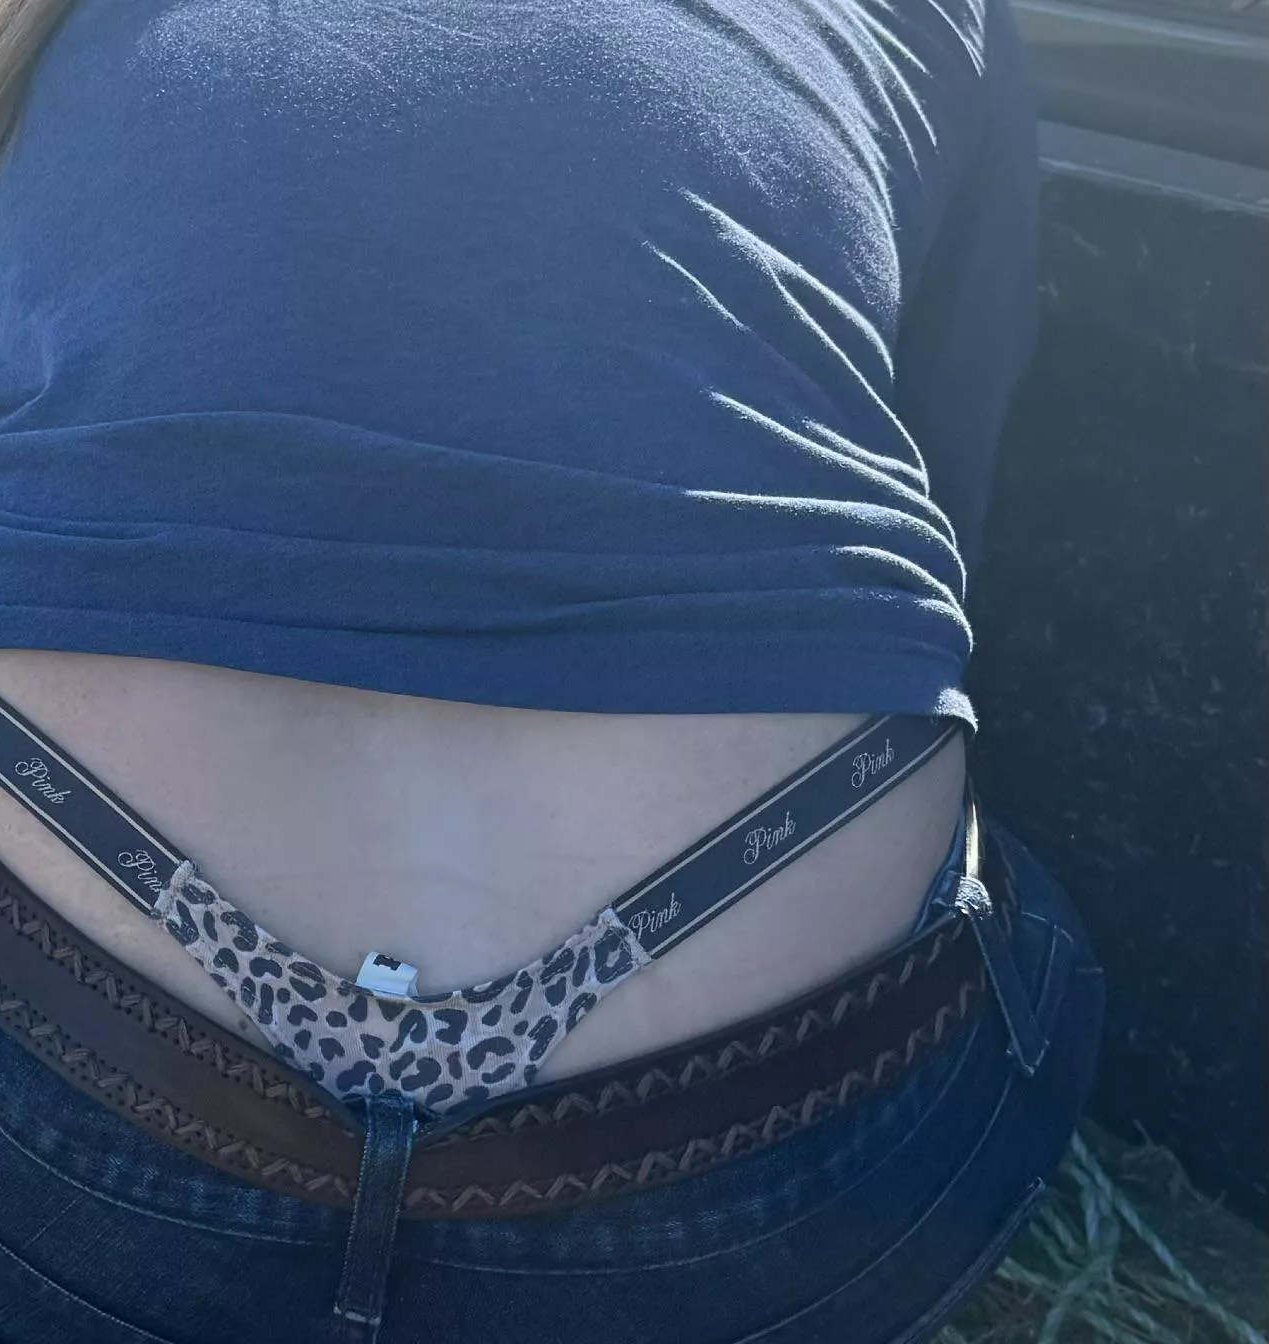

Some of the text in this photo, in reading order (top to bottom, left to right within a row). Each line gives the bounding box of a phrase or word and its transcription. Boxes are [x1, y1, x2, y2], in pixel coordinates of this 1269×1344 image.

[14, 757, 72, 804] Pink
[851, 738, 895, 788] Pink
[743, 811, 796, 865] Pink
[117, 849, 160, 892] Pin
[627, 892, 682, 939] Pink
